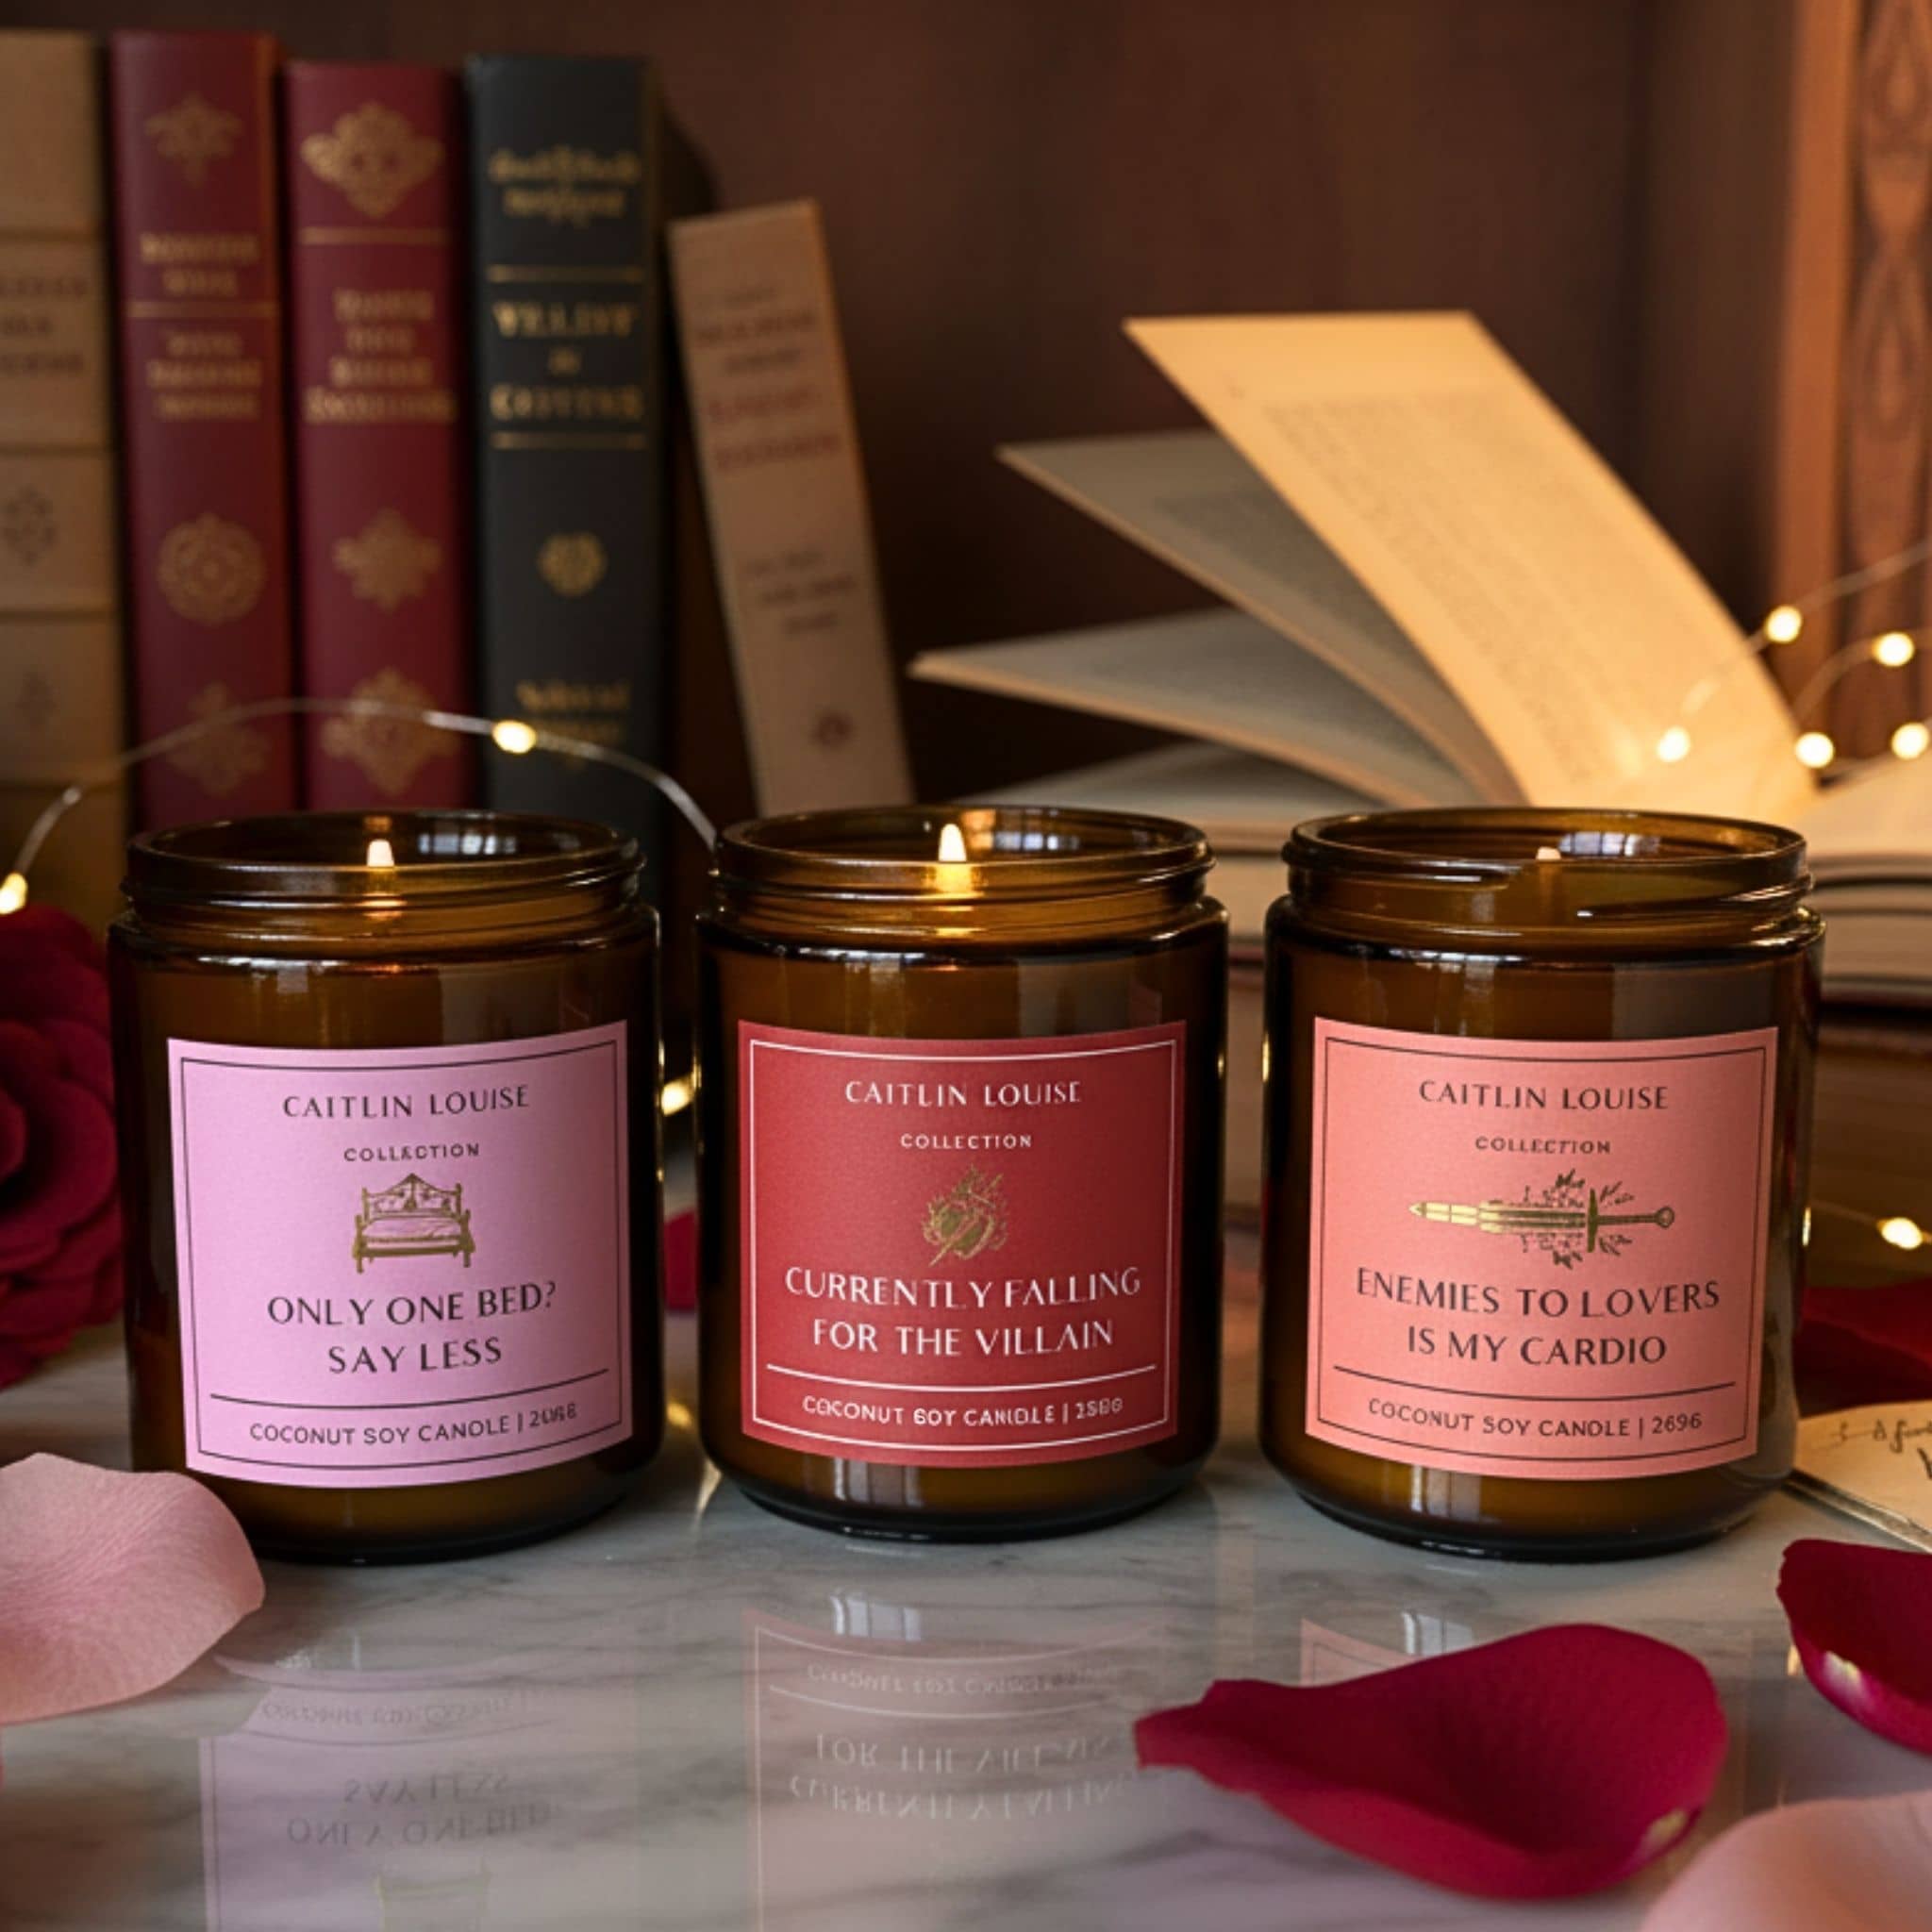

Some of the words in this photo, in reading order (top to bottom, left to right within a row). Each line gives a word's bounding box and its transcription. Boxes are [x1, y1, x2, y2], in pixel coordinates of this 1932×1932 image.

[282, 1095, 412, 1118] CAITLIN
[429, 1086, 527, 1116] LOUISE
[845, 1081, 967, 1108] CAITLIN
[983, 1080, 1082, 1108] LOUISE
[1419, 1080, 1546, 1108] CAITLIN
[1561, 1086, 1667, 1110] LOUISE
[900, 1133, 1031, 1151] COLLECTION
[1474, 1136, 1610, 1155] COLLECTION
[267, 1296, 374, 1326] ONLY
[386, 1292, 463, 1325] ONE
[477, 1281, 556, 1318] BED?
[785, 1266, 992, 1308] CURRENTLY
[1005, 1267, 1141, 1307] FALLING
[1357, 1267, 1500, 1314] ENEMIES
[1516, 1289, 1569, 1318] TO
[1580, 1280, 1720, 1318] LOVERS
[328, 1345, 405, 1374] SAY
[420, 1337, 502, 1372] LESS
[813, 1318, 878, 1352] FOR
[895, 1326, 959, 1357] THE
[974, 1321, 1111, 1356] VILLAIN
[1408, 1325, 1436, 1355] IS
[1448, 1331, 1507, 1362] MY
[1520, 1336, 1666, 1366] CARDIO
[249, 1423, 356, 1446] COCONUT
[363, 1426, 410, 1446] SOY
[1368, 1398, 1475, 1433] COCONUT
[1482, 1415, 1532, 1437] SOY
